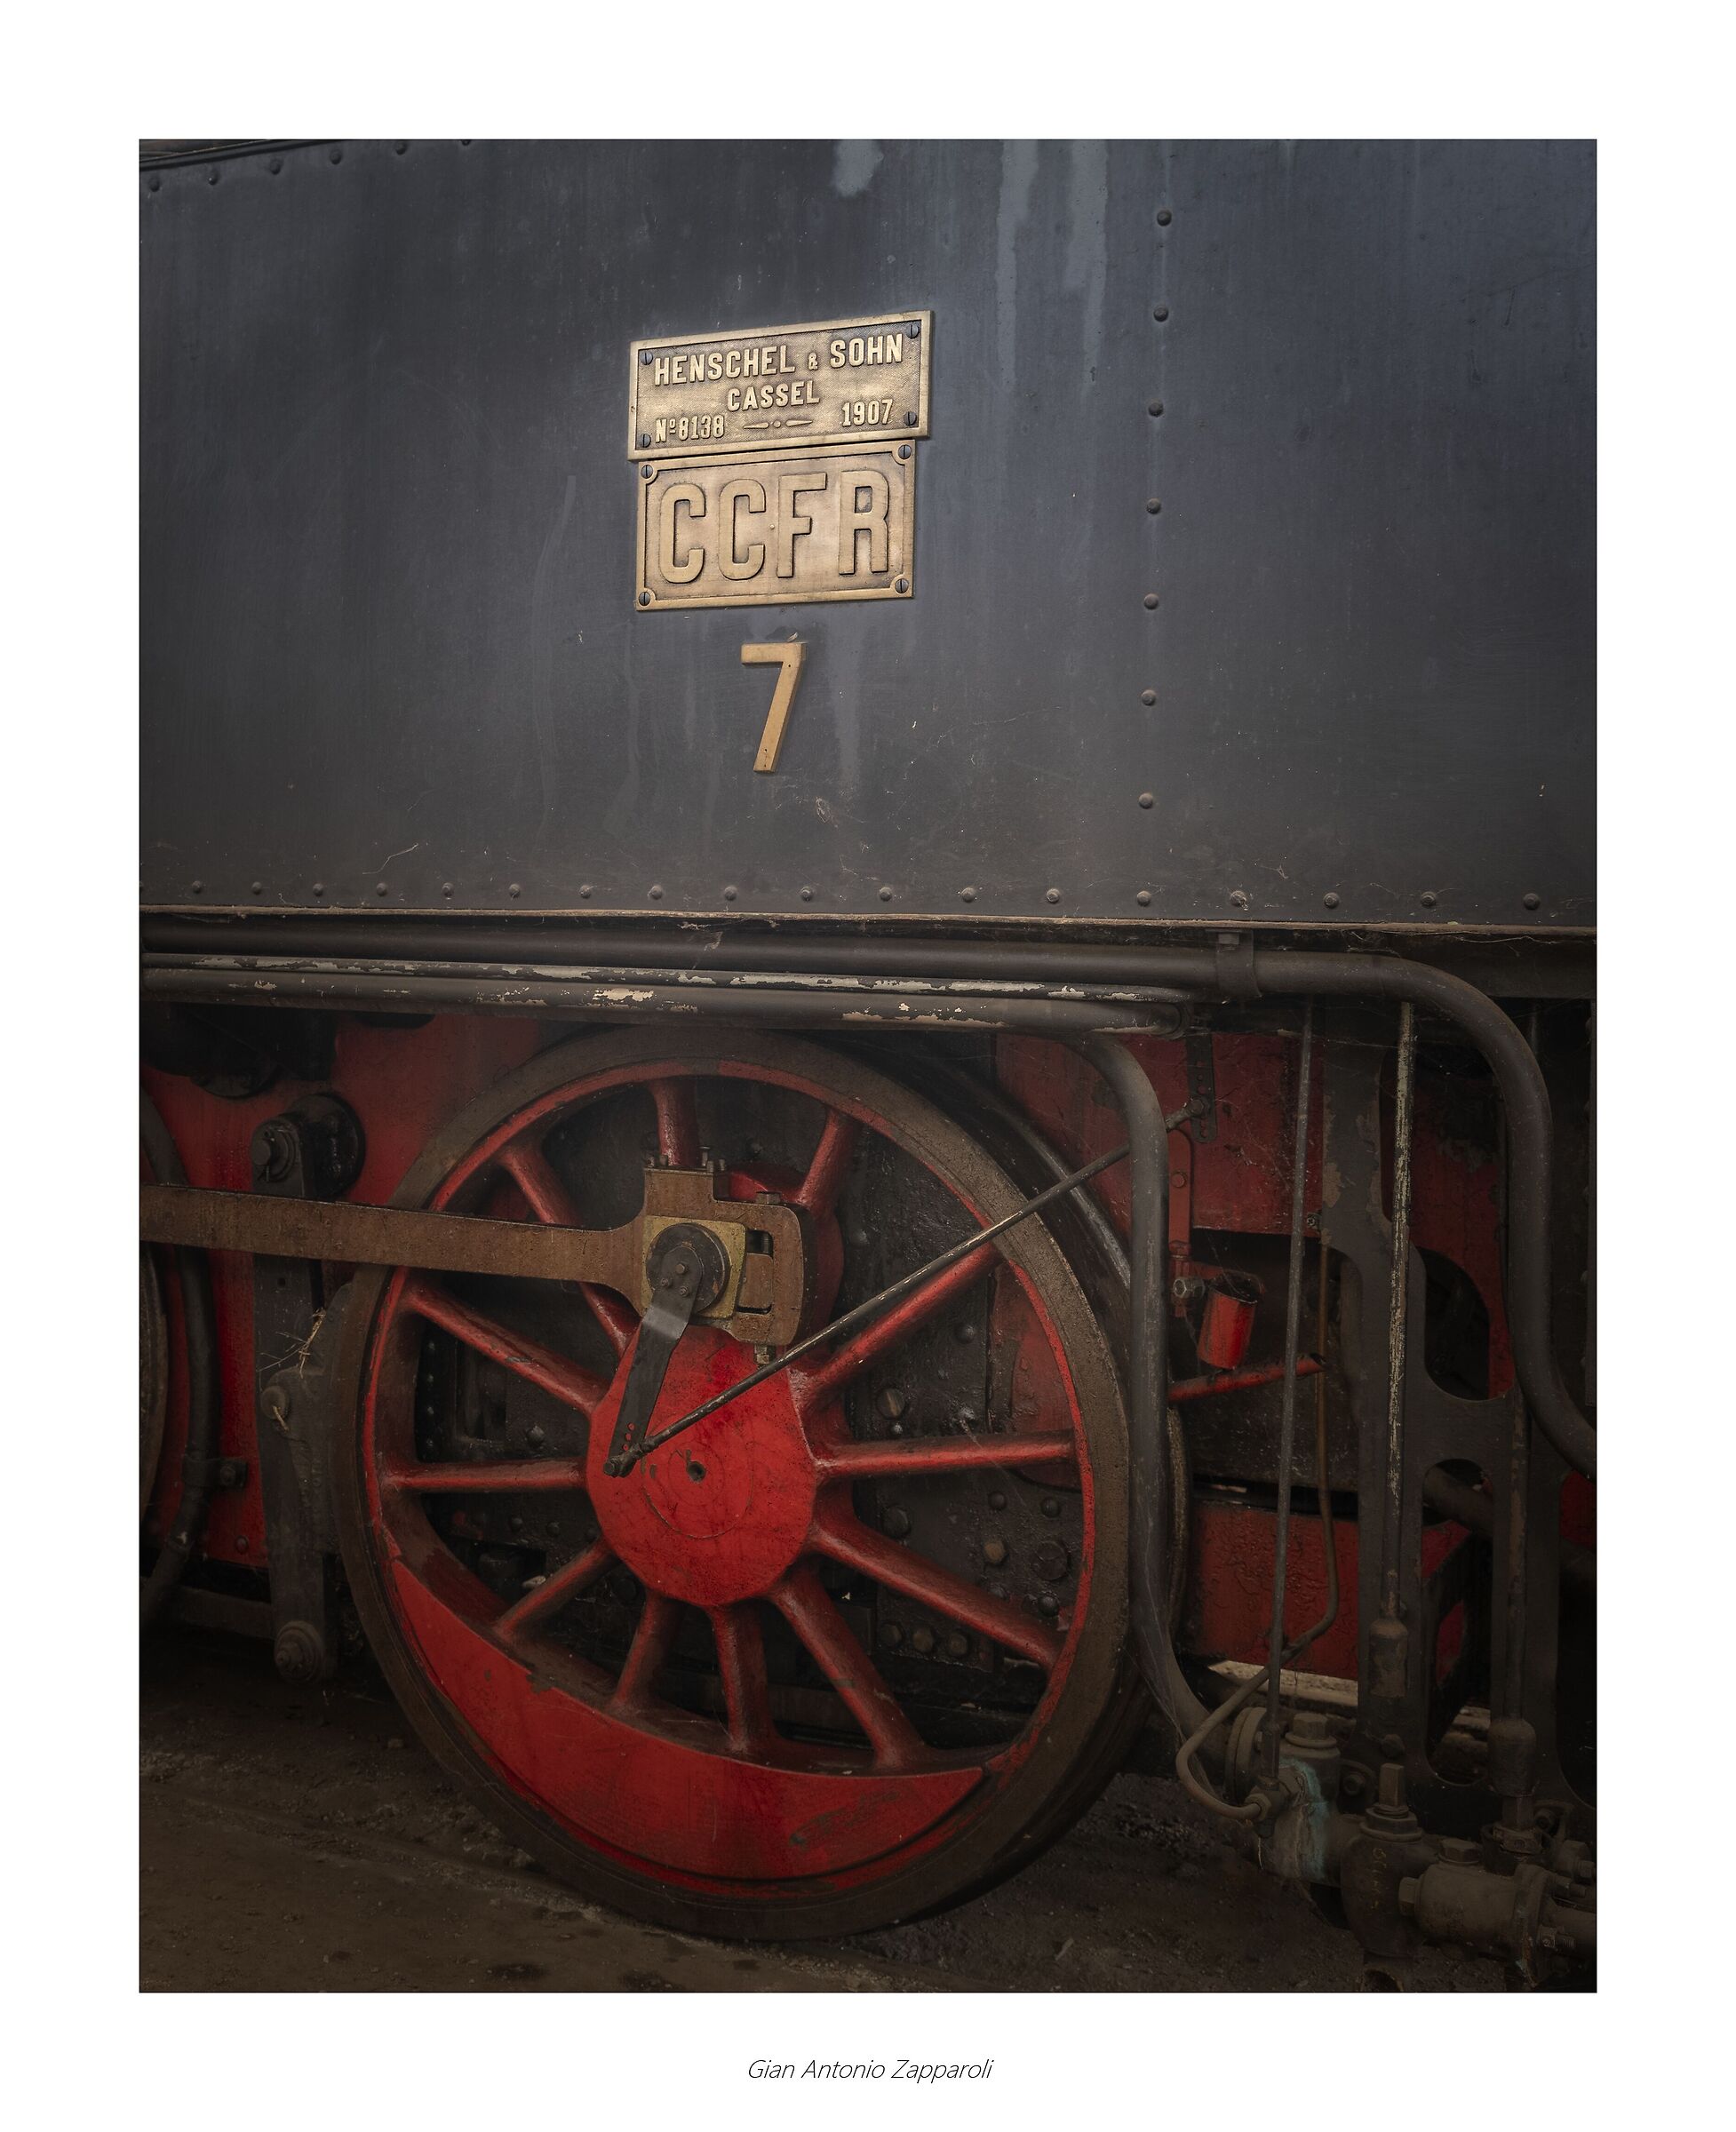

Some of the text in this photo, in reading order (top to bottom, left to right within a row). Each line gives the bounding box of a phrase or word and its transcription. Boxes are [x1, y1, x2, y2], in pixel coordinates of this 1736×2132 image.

[654, 333, 904, 386] HENSCHEL & SOHN
[727, 380, 820, 411] CASSEL
[841, 399, 894, 426] 1907
[658, 469, 890, 585] CCFR
[740, 641, 807, 774] 7
